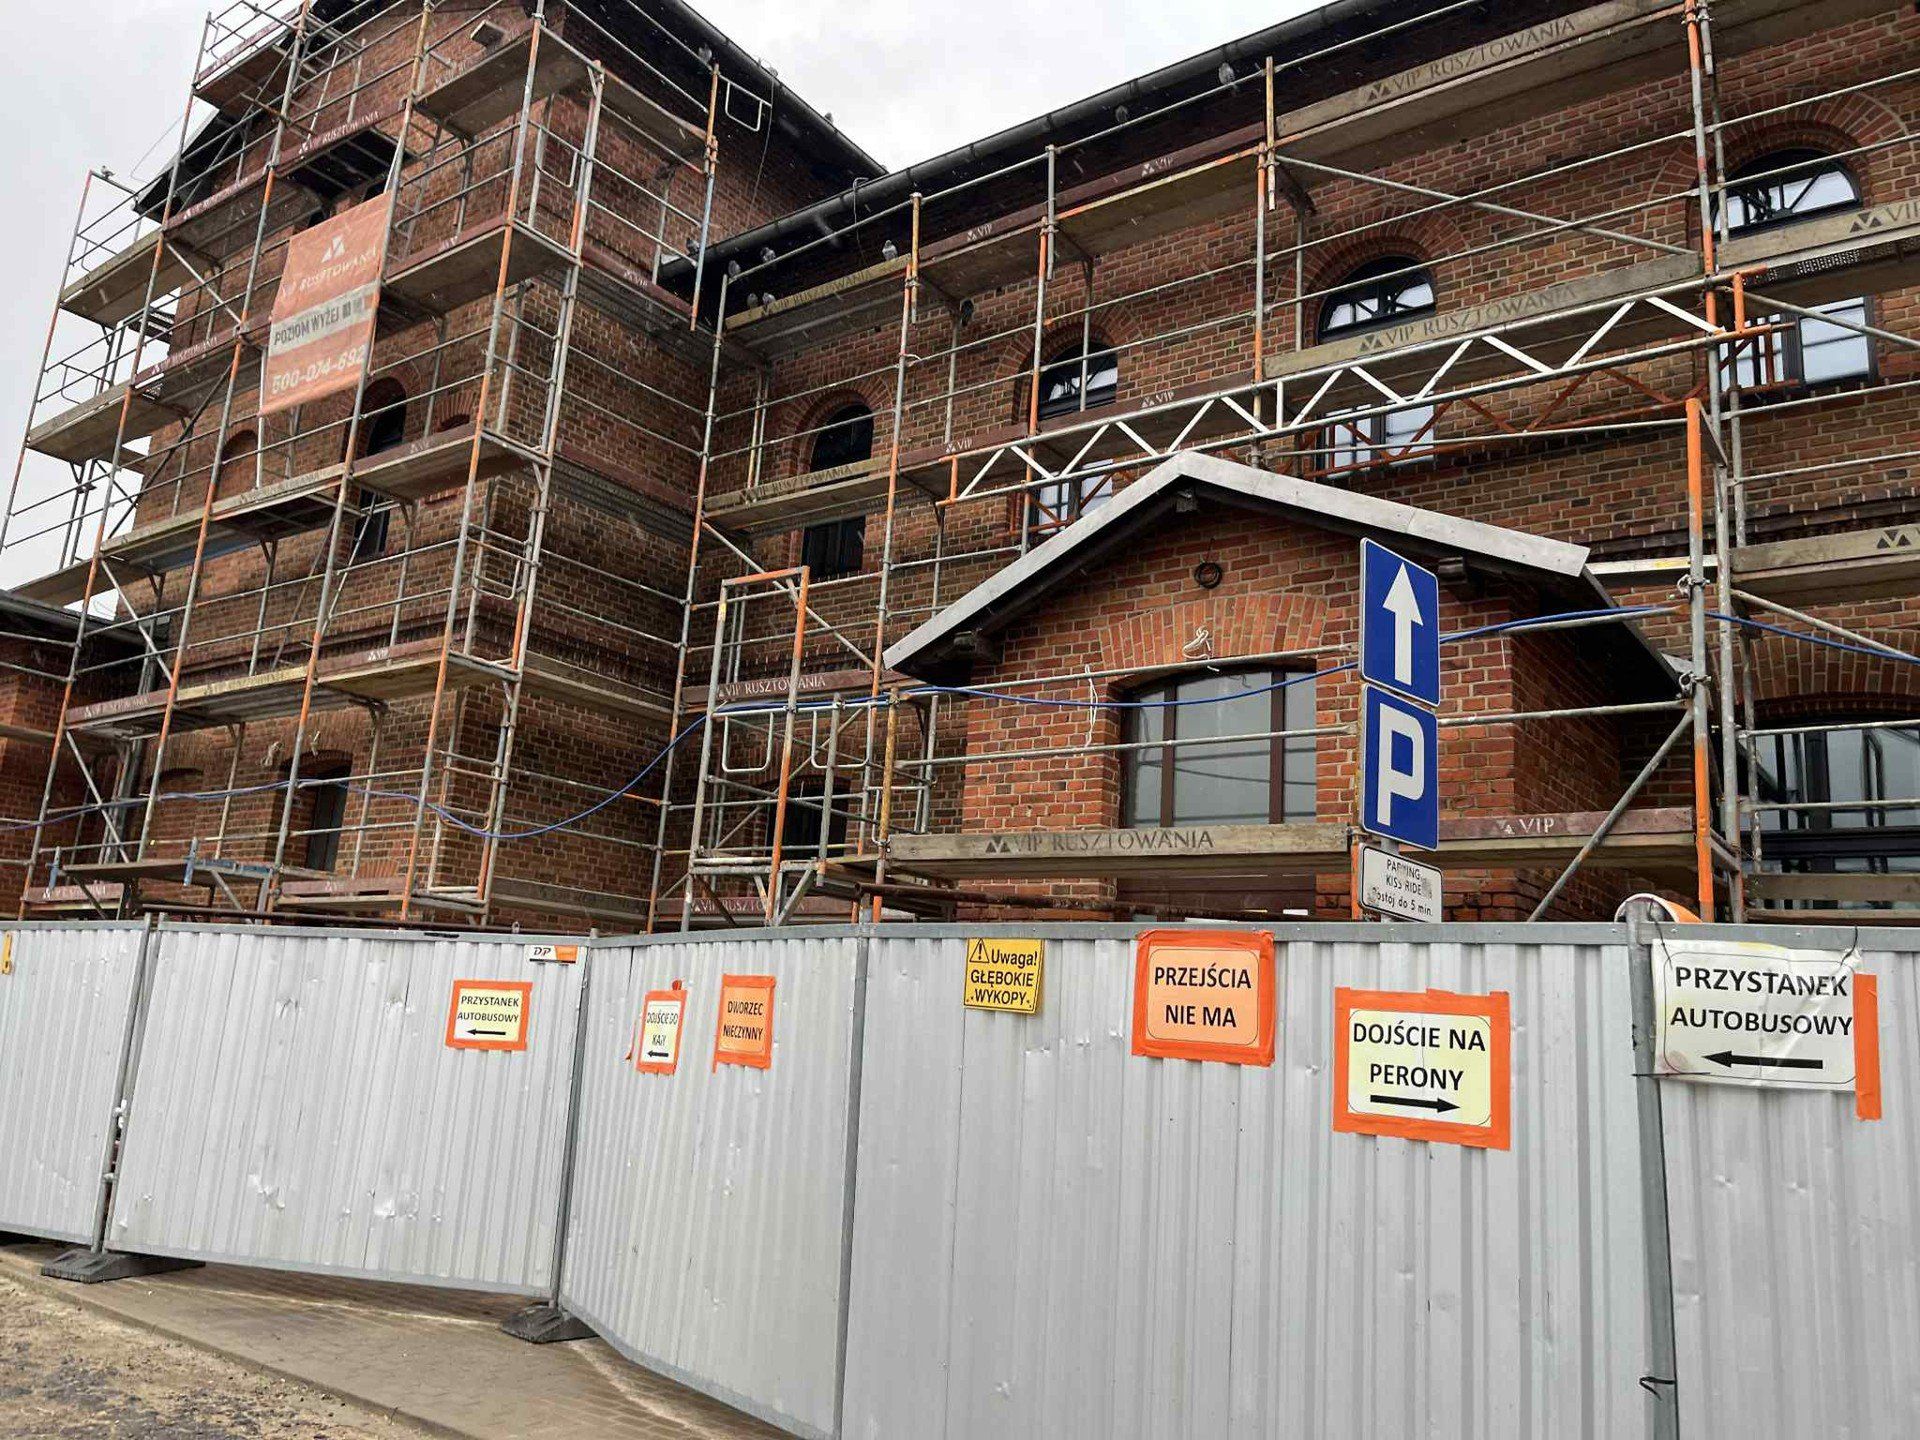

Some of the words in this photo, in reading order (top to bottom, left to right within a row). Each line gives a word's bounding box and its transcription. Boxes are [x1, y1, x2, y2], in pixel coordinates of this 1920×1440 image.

[1393, 69, 1421, 92] VIP
[1430, 18, 1576, 78] RUSZTOWANIA
[1385, 325, 1414, 345] VIP
[1424, 286, 1577, 334] RUSZTOWANIA
[273, 319, 310, 346] POZIOM
[1155, 391, 1175, 404] VIP
[1377, 703, 1425, 827] P
[1519, 818, 1555, 834] VIP
[1015, 836, 1043, 851] VIP
[1053, 830, 1215, 851] RUSZTOWANIA
[1399, 896, 1408, 909] do
[1411, 899, 1416, 911] 5
[991, 949, 1038, 969] Uwaga!
[970, 969, 1034, 988] GŁĘBOKIE
[1154, 962, 1252, 989] PRZEJŚCIA
[1675, 966, 1847, 997] PRZYSTANEK
[461, 995, 520, 1008] PRZYSTANEK
[975, 988, 1027, 1005] WYKOPY
[457, 1011, 519, 1023] AUTOBUSOWY
[727, 1000, 764, 1016] DWORZEC
[1165, 1004, 1196, 1025] NIE
[1203, 1006, 1237, 1028] MA
[1671, 1006, 1853, 1036] AUTOBUSOWY
[723, 1024, 764, 1041] NIECZYNNY
[1353, 1020, 1440, 1048] DOJŚCIE
[1450, 1029, 1486, 1051] NA
[1370, 1063, 1464, 1091] PERONY
